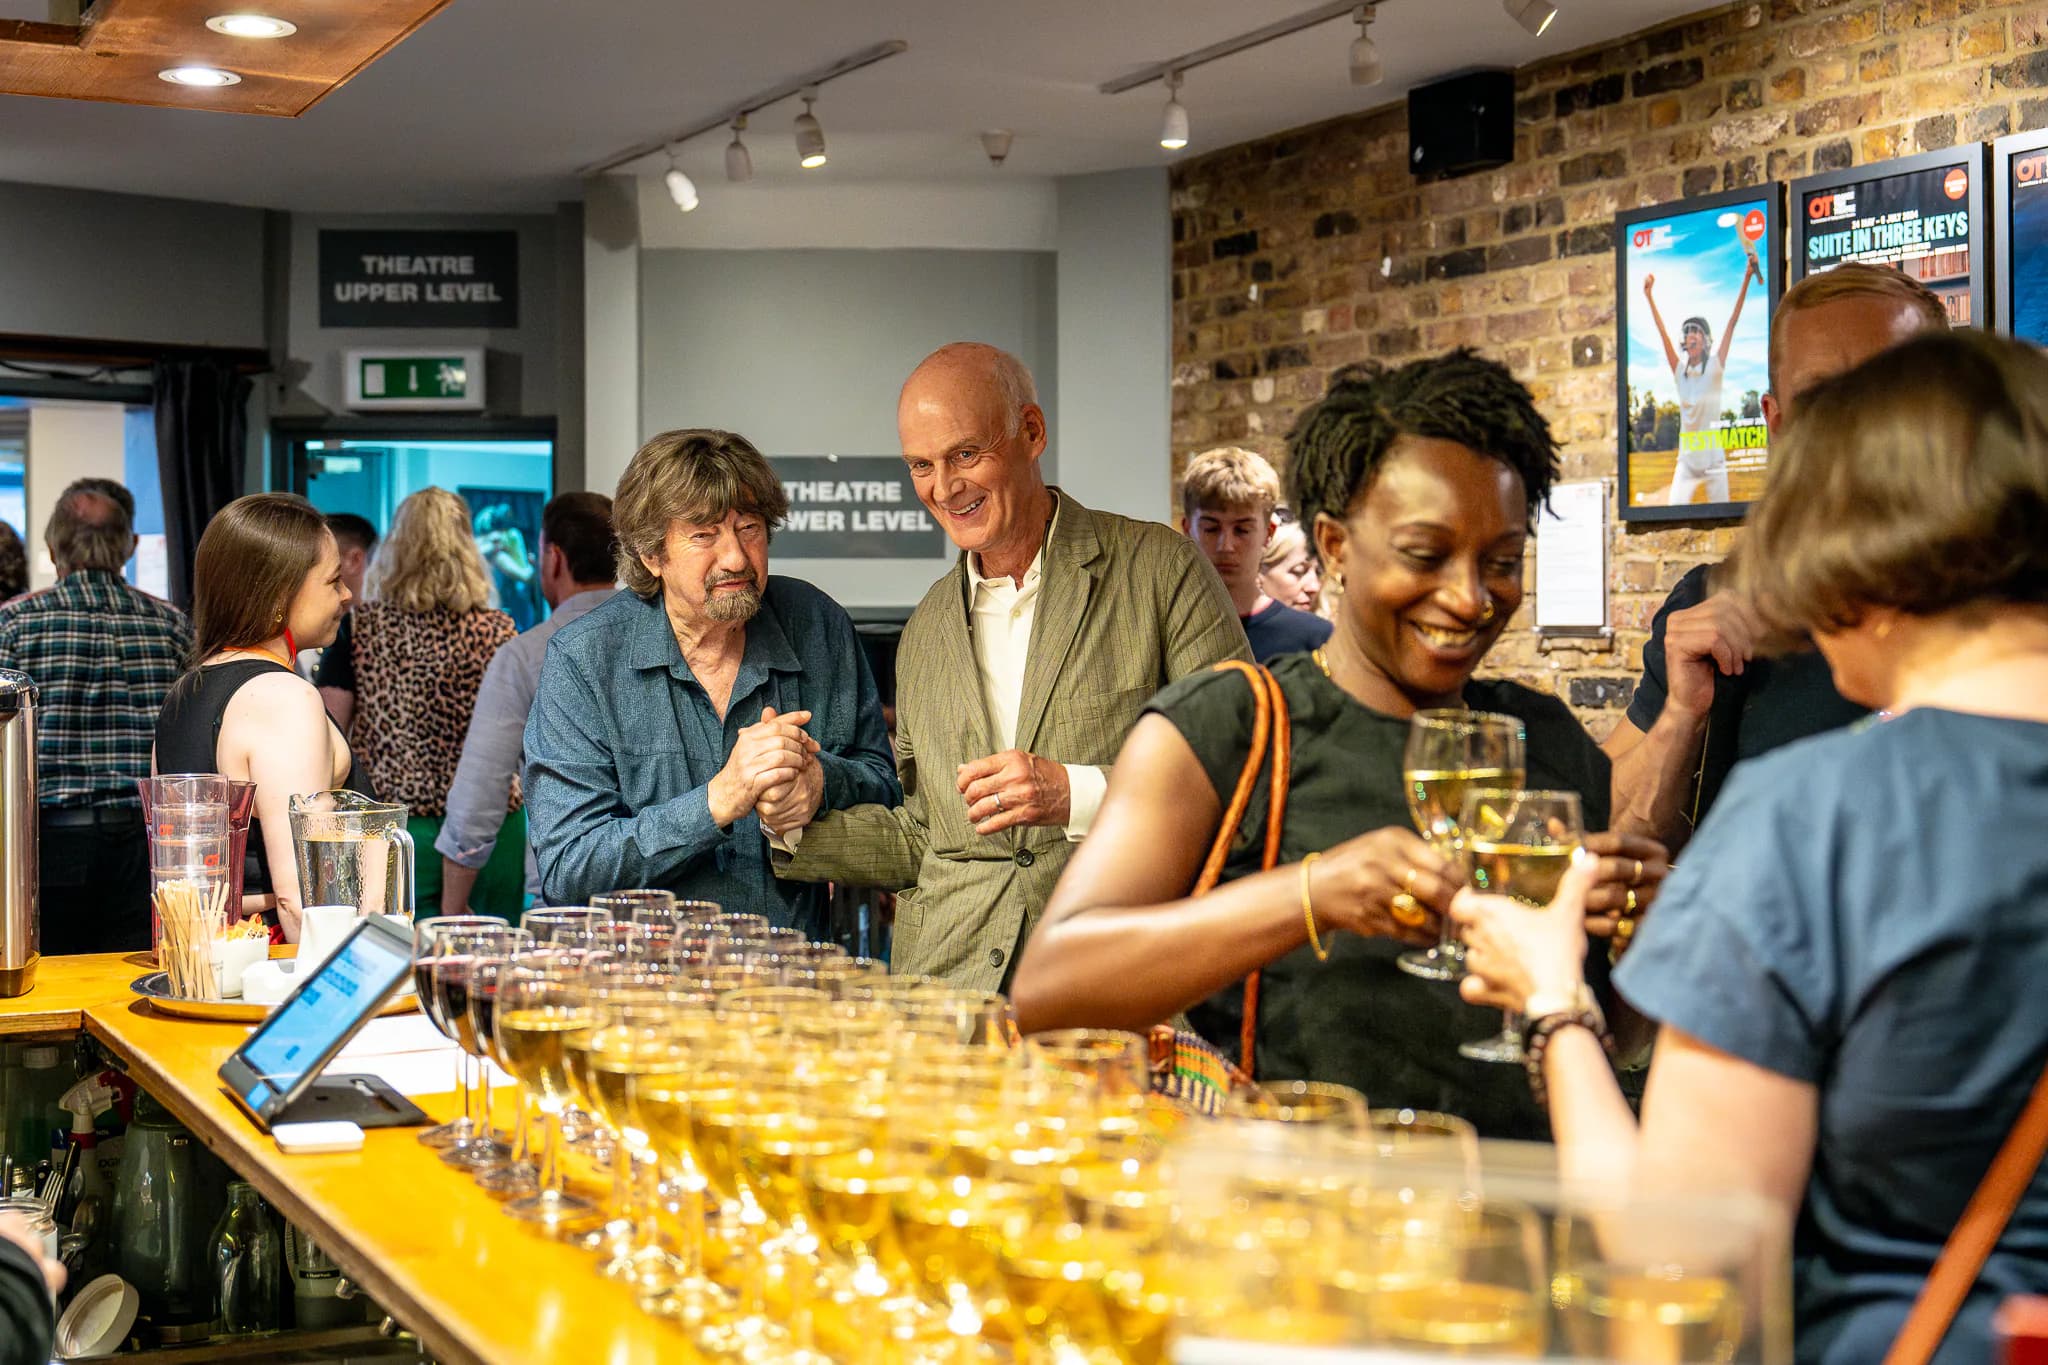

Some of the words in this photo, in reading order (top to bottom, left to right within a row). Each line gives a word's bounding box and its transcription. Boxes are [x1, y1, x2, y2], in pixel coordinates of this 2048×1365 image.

[1808, 231, 1852, 260] SUITE
[1853, 228, 1871, 253] IN
[1872, 218, 1922, 249] THREE
[1924, 211, 1969, 241] KEYS
[361, 255, 475, 275] THEATRE
[334, 283, 418, 302] UPPER
[425, 283, 502, 302] LEVEL
[783, 480, 902, 502] THEATRE
[778, 510, 845, 532] WER
[852, 510, 933, 532] LEVEL
